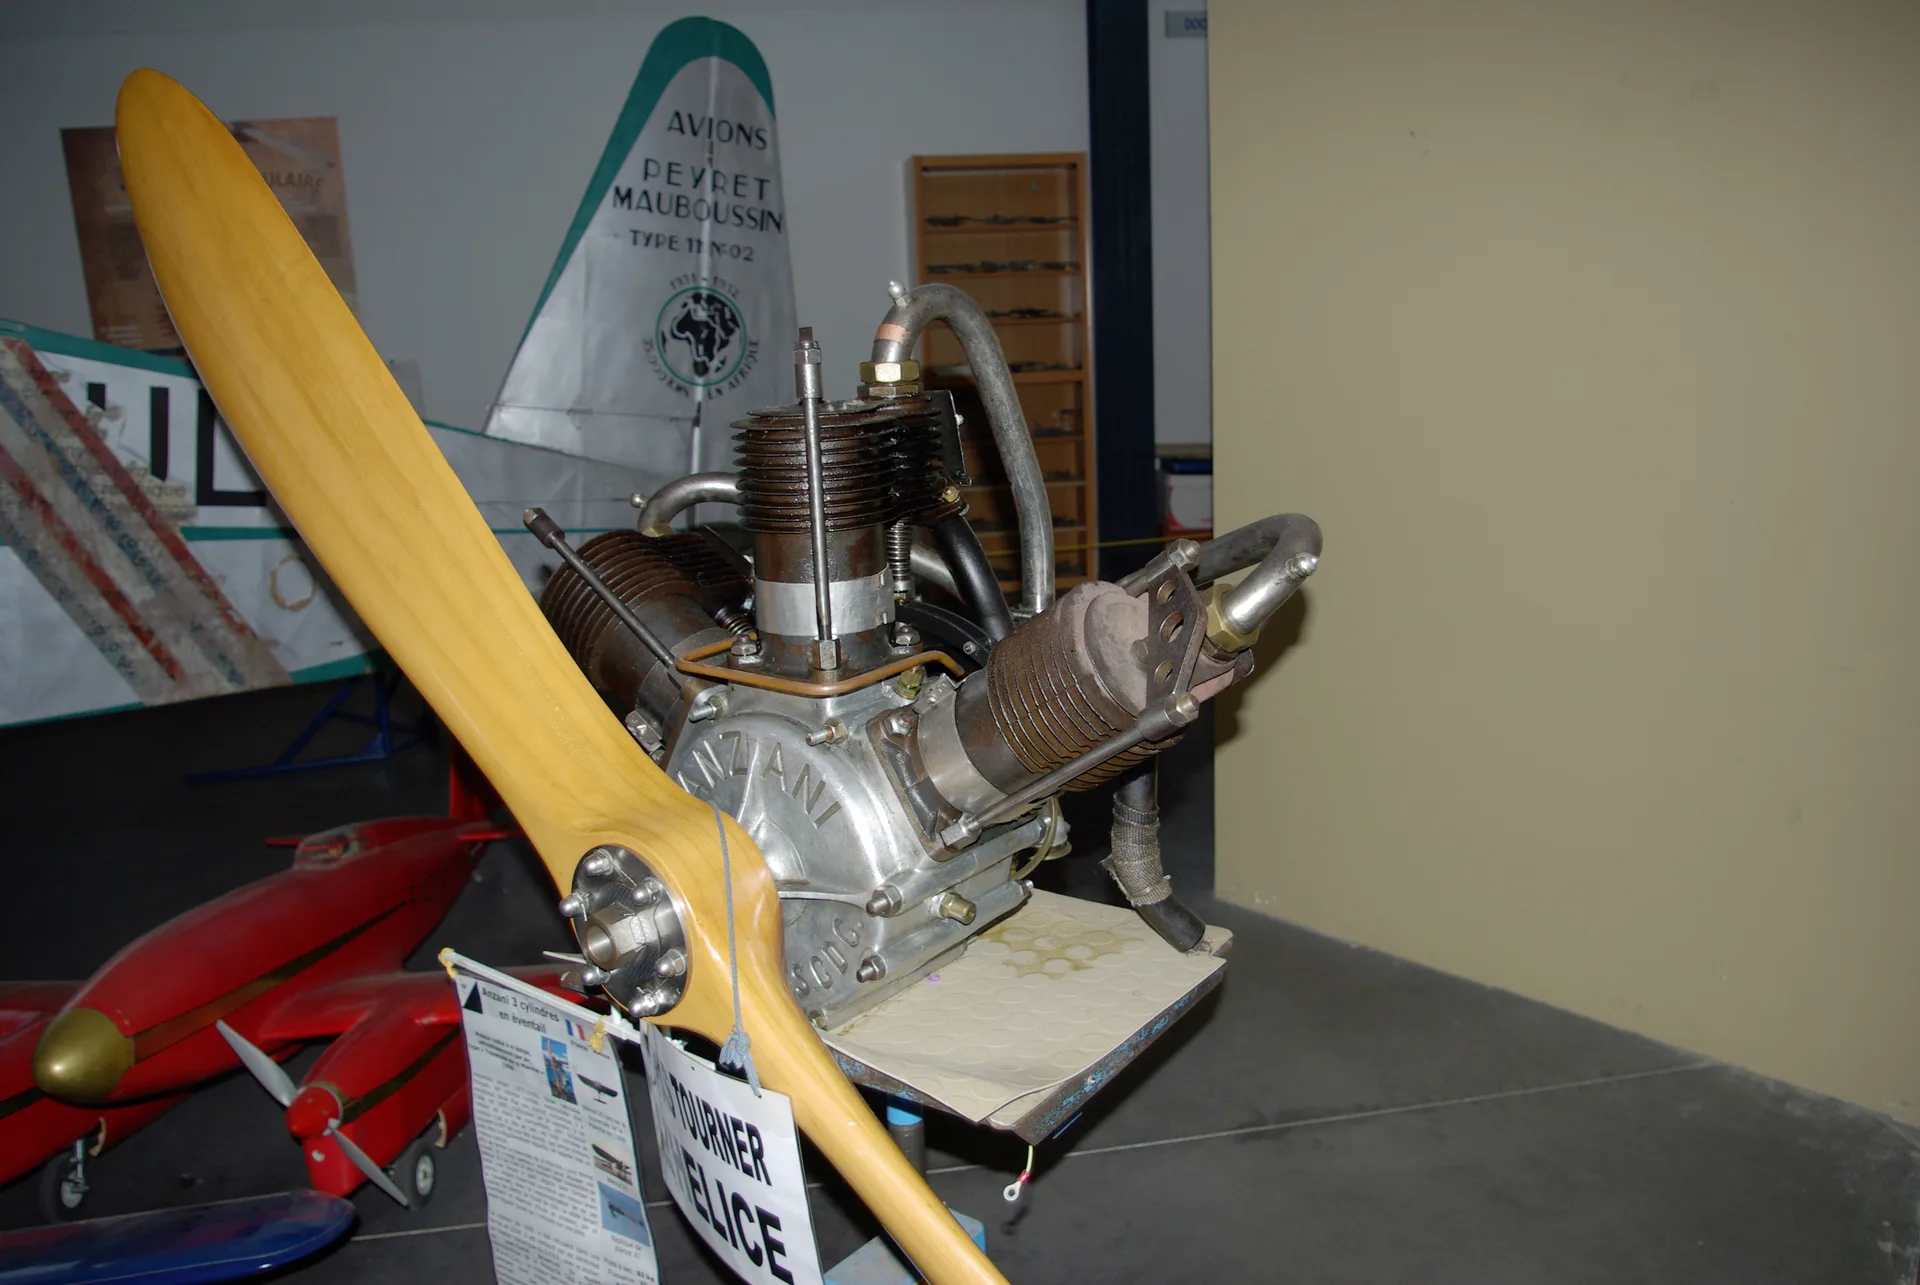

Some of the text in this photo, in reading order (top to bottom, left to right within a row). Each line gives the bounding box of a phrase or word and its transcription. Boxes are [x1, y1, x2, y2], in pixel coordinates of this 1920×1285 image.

[666, 109, 768, 151] AVIONS
[643, 158, 771, 201] PEYRET
[612, 185, 783, 233] MAUBOUSSIN
[629, 229, 680, 252] TYPE
[482, 987, 560, 1022] Anzani 3 cylindres
[499, 1010, 510, 1021] en
[669, 1072, 773, 1187] TOURNER
